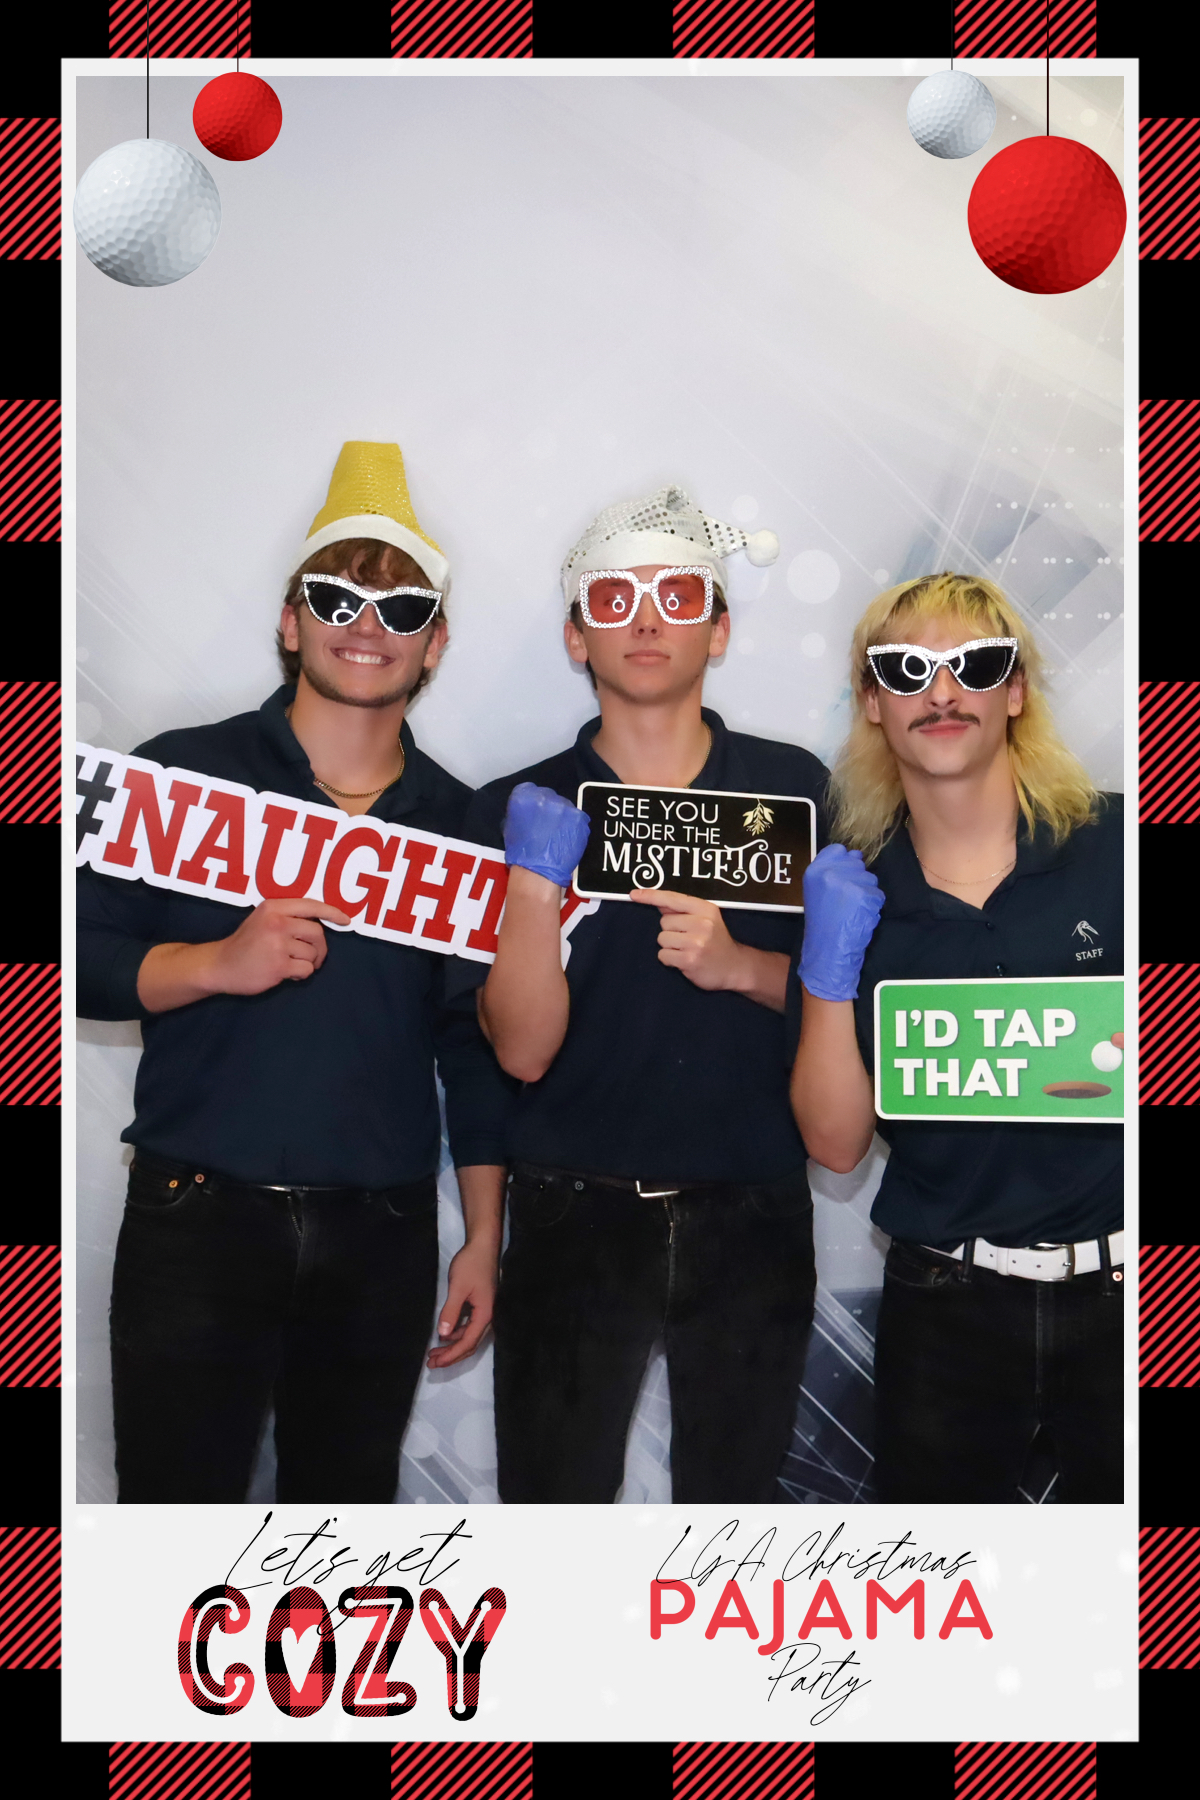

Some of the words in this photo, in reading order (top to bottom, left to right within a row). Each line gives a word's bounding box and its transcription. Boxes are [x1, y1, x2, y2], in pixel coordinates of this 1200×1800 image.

[606, 795, 650, 819] SEE
[659, 799, 719, 824] YOU
[604, 819, 675, 842] UNDER
[682, 825, 721, 845] THE
[76, 754, 591, 953] #NAUGHT
[602, 838, 792, 890] MISTLETOE
[1075, 947, 1104, 962] STAFF
[895, 1009, 960, 1048] I'D
[973, 1008, 1077, 1048] TAP
[893, 1057, 1029, 1097] THAT
